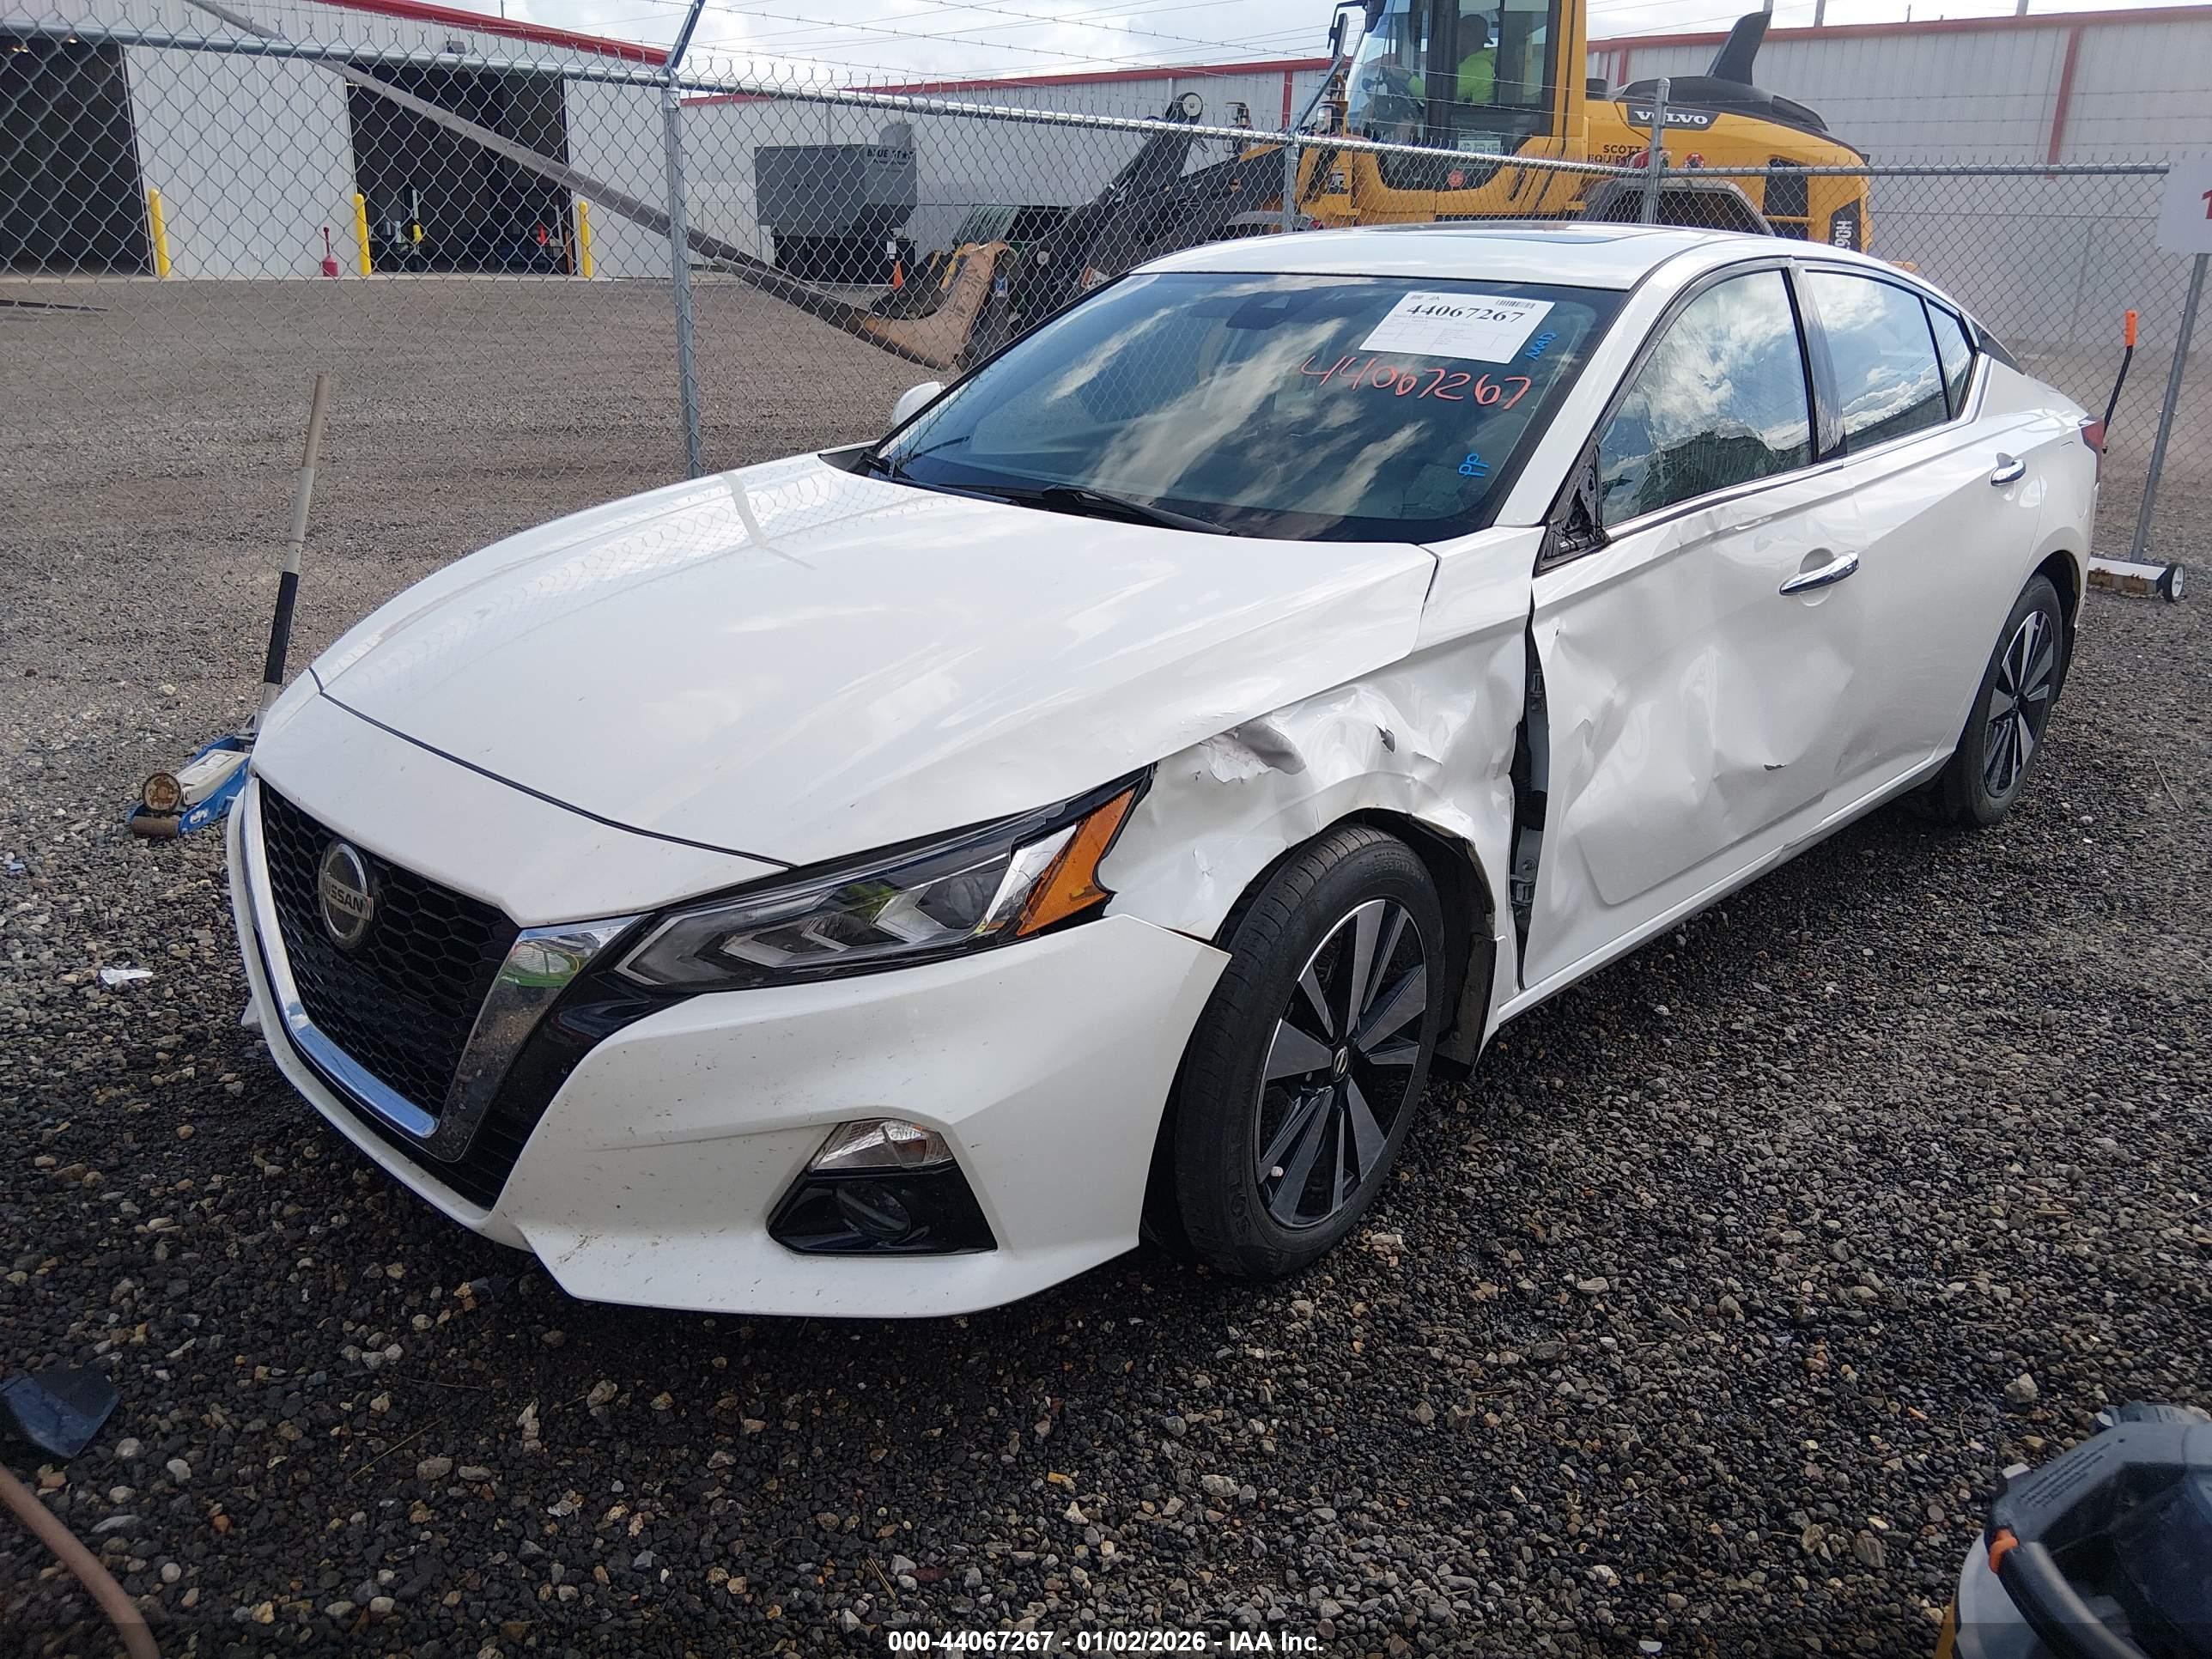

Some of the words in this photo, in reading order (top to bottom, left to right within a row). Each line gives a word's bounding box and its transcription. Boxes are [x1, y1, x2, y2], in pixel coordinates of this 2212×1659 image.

[1634, 111, 1708, 125] VLVO
[1603, 144, 1642, 154] SCOTT
[1834, 220, 1852, 250] 90H
[1407, 304, 1525, 323] 44067267
[1300, 355, 1532, 410] 44067267
[322, 877, 363, 914] NISSAN
